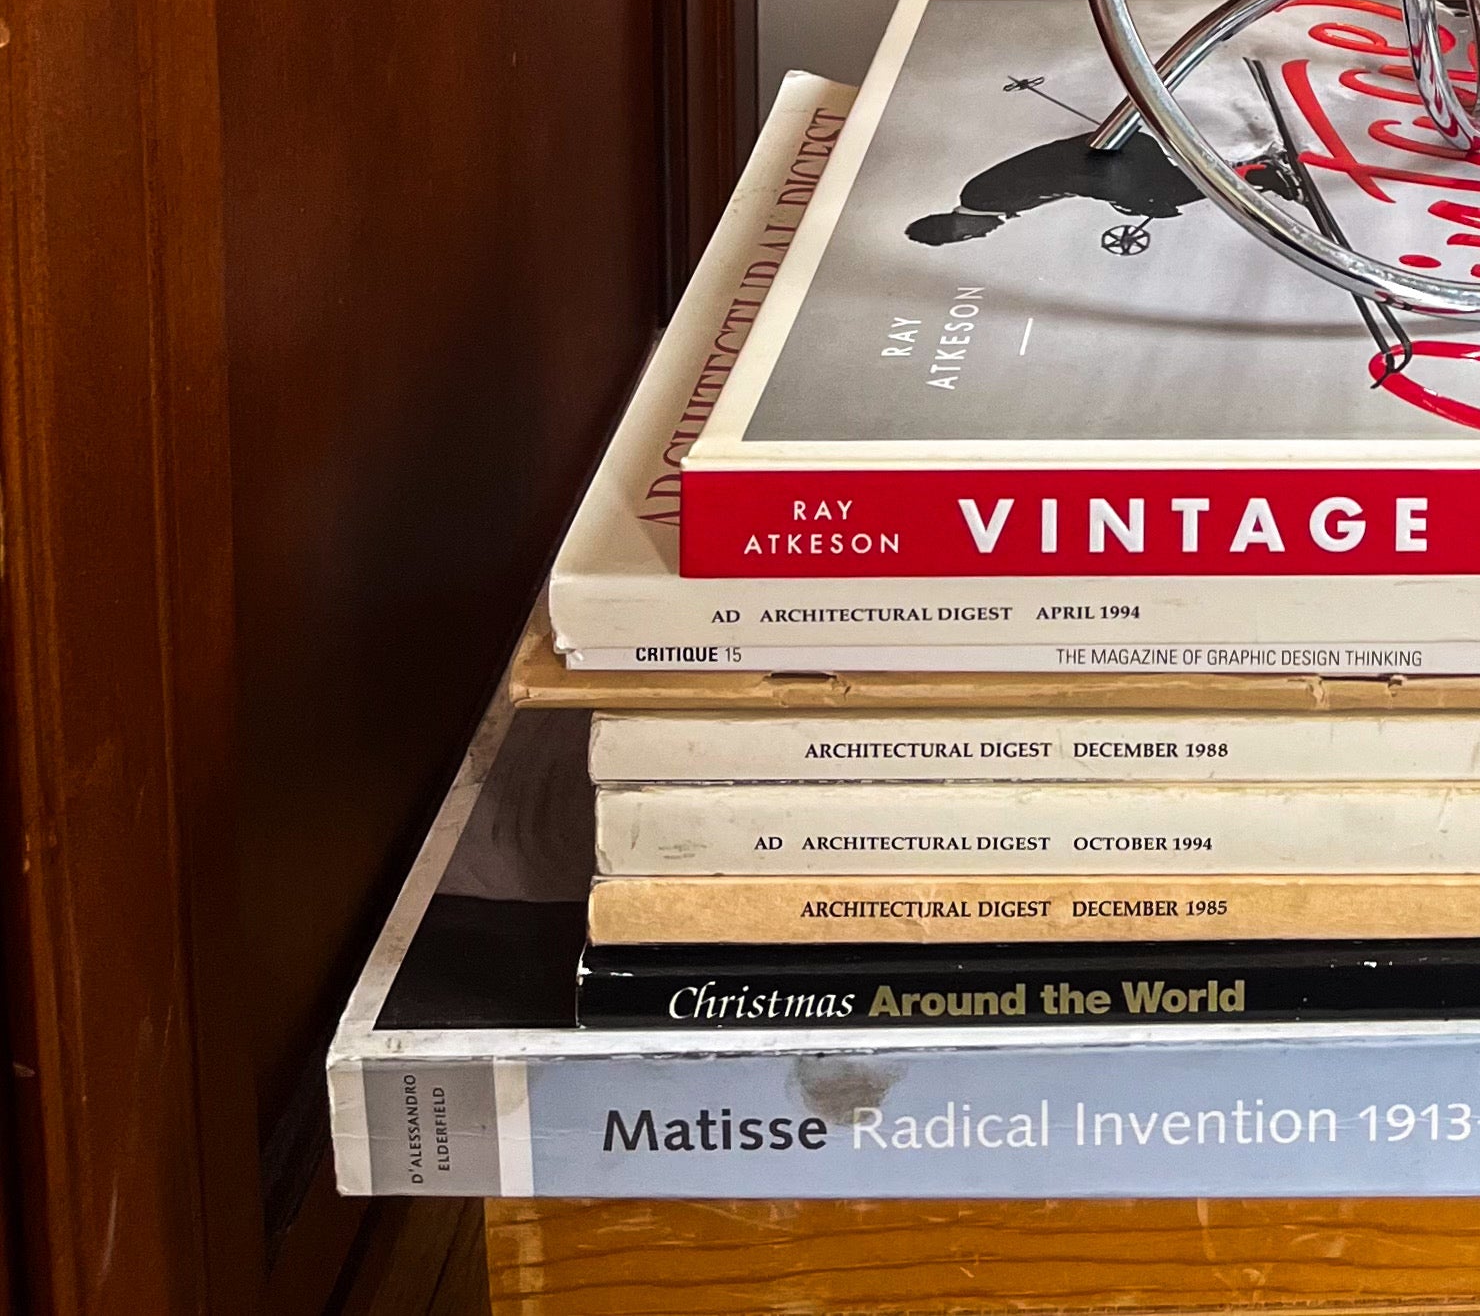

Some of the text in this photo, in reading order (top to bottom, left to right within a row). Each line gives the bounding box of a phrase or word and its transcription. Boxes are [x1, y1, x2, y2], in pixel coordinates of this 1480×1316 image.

[880, 317, 922, 356] RAY
[926, 287, 985, 390] ATKESON
[793, 500, 853, 521] RAY
[958, 496, 1428, 554] VINTAGE
[743, 533, 899, 555] ATKESON
[711, 605, 1140, 624] AD ARCHITECTURAL DIGEST APRIL 1994
[635, 646, 742, 663] CRITIQUE 15
[1056, 648, 1422, 667] THE MAGAZINE OF GRAPHIC DESIGN THINKING
[804, 742, 1229, 759] ARCHITECTURAL DIGEST DECEMBER 1988
[754, 836, 1213, 851] AD ARCHITECTURAL DIGEST OCTOBER 1994
[800, 900, 1228, 919] ARCHITECTURAL DIGEST DECEMBER 1985
[668, 979, 1245, 1020] Christmas Around the World
[403, 1074, 424, 1185] D'ALESSANDRO
[432, 1087, 450, 1171] ELDERFIELD
[602, 1108, 828, 1152] Matisse
[853, 1099, 1049, 1149] Radical
[1076, 1099, 1337, 1146] Invention
